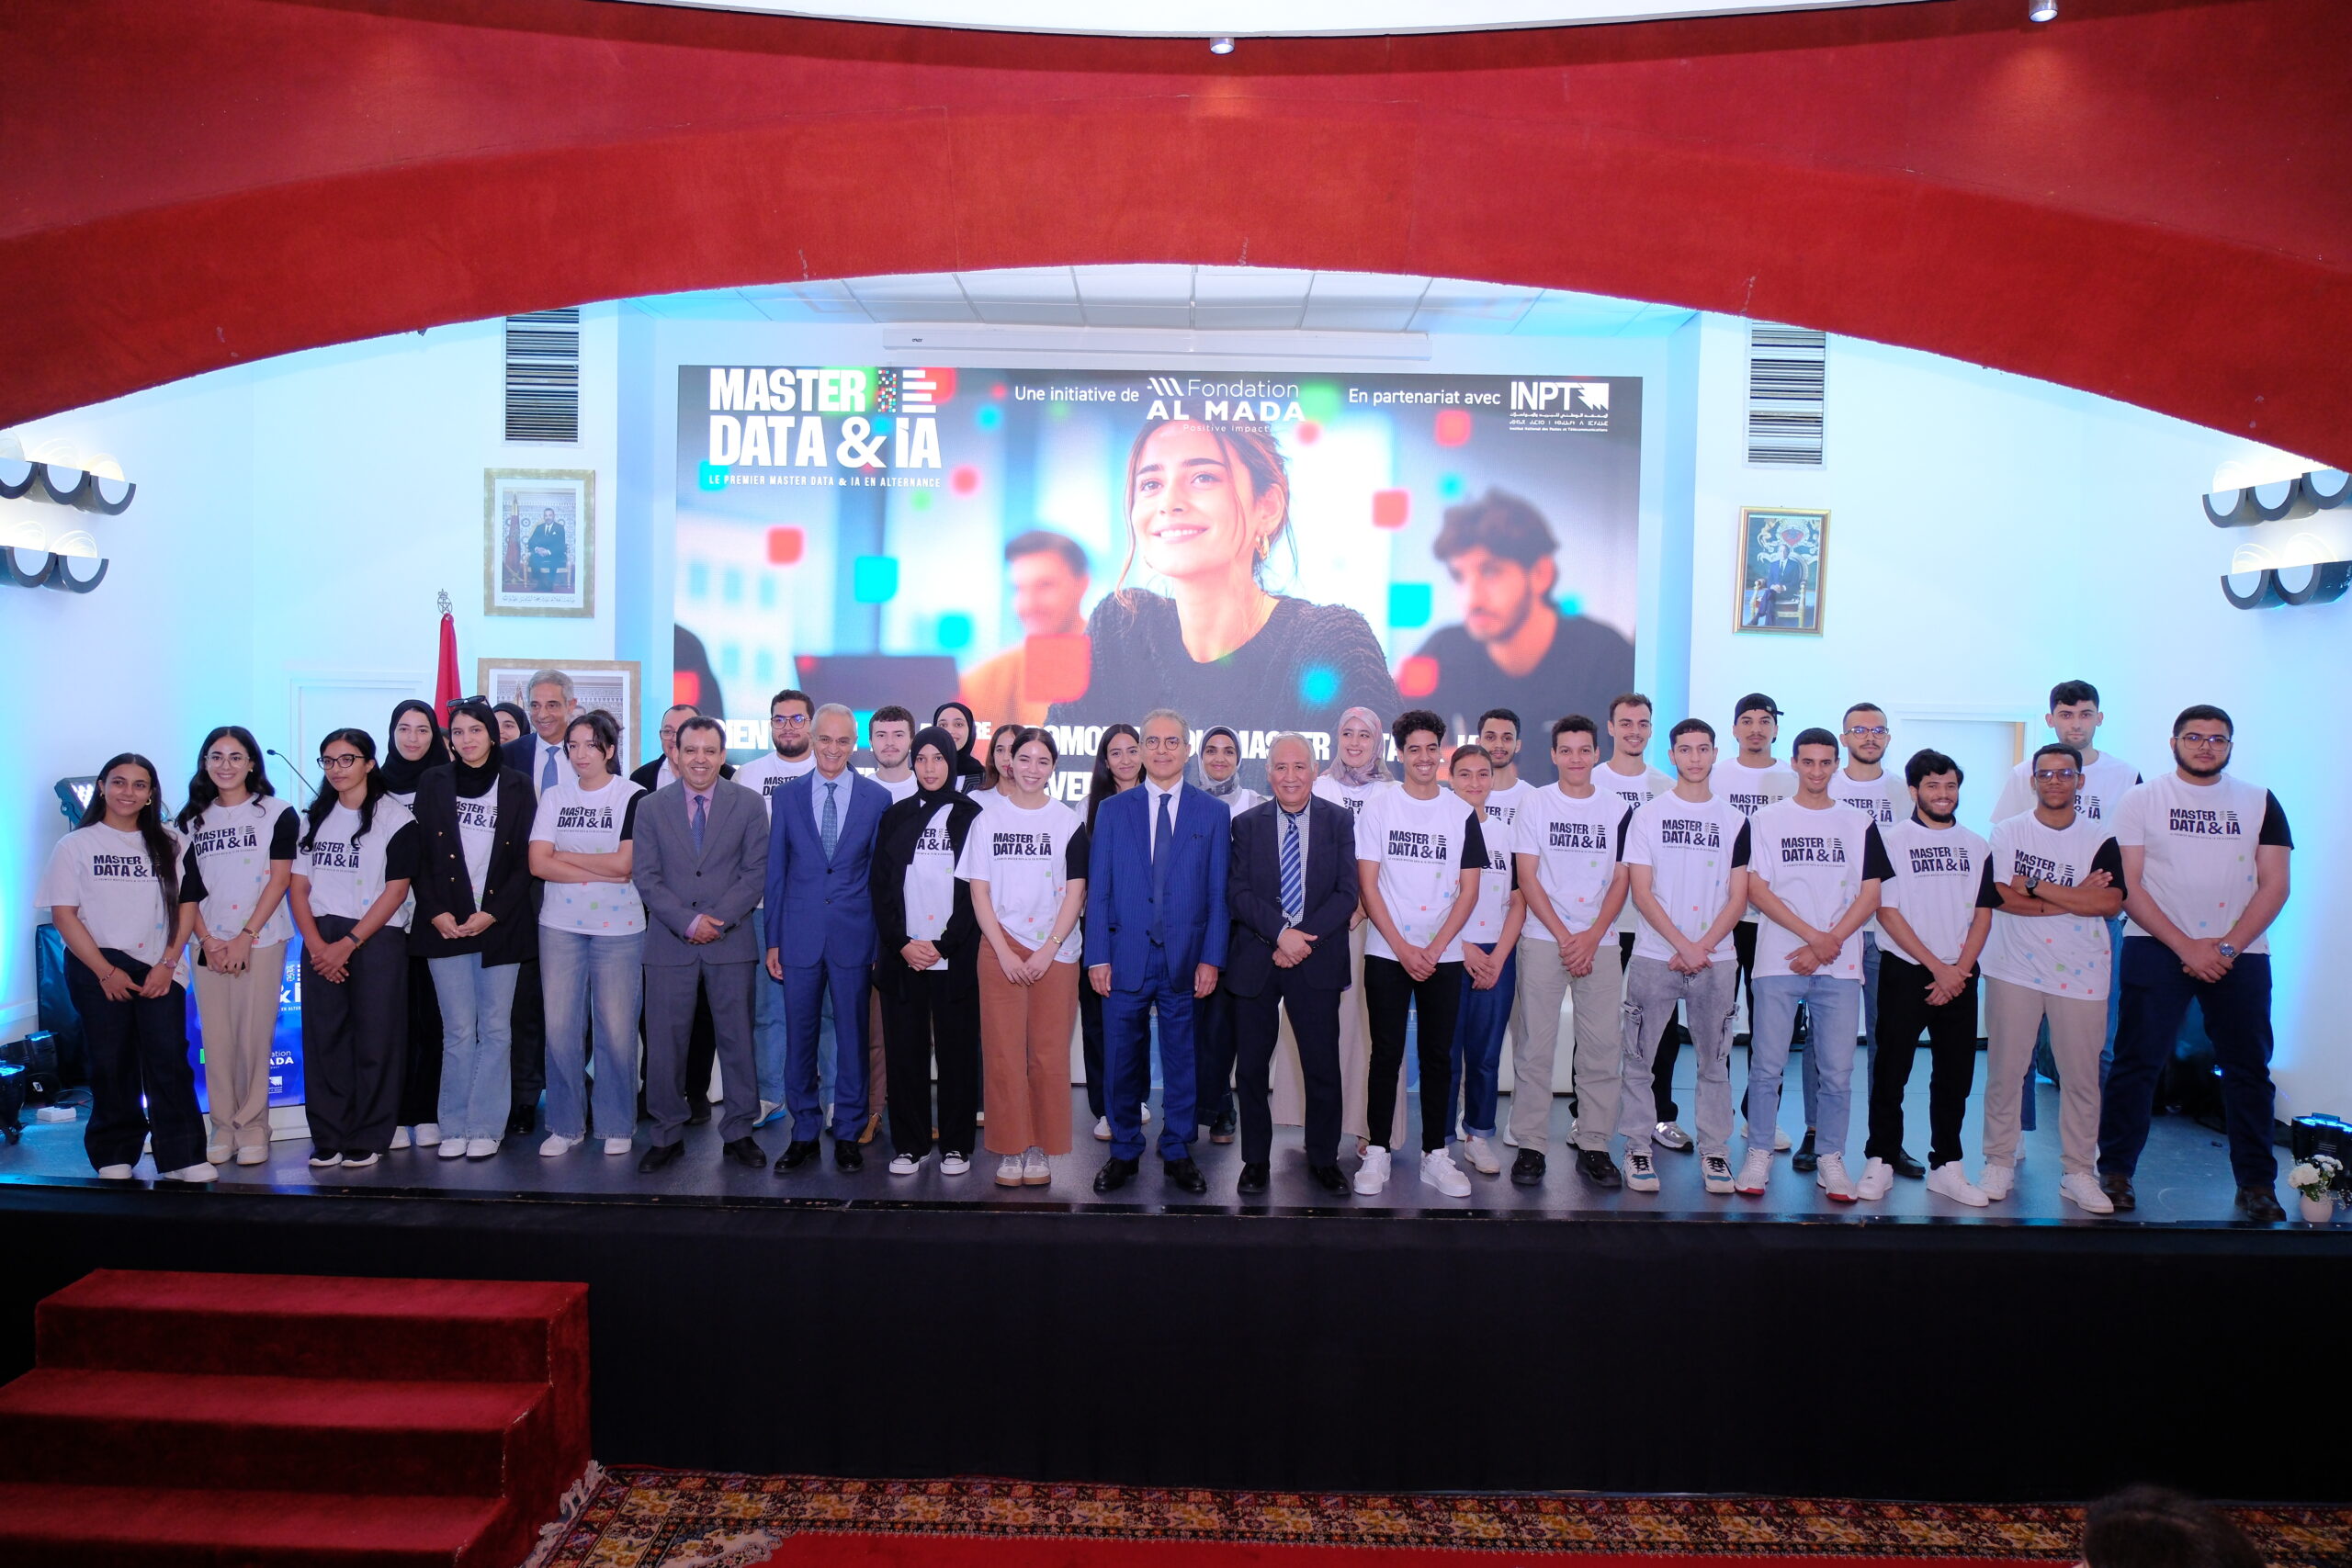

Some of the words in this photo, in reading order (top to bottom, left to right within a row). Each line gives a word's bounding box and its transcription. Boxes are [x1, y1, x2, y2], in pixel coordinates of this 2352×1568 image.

[709, 367, 866, 412] MASTER
[1015, 386, 1046, 400] Une
[1050, 387, 1116, 401] initiative
[1121, 388, 1139, 401] de
[1188, 379, 1299, 398] Fondation
[1349, 389, 1368, 403] En
[1373, 389, 1460, 406] partenariat
[1464, 392, 1500, 405] avec
[1510, 381, 1582, 411] INPT
[1146, 400, 1190, 421] AL
[1204, 400, 1306, 422] MADA
[1183, 423, 1227, 433] Positive
[709, 415, 828, 467] DATA
[836, 416, 888, 468] &
[709, 475, 720, 484] LE
[724, 475, 765, 485] PREMIER
[770, 476, 807, 486] MASTER
[811, 477, 834, 486] DATA
[838, 478, 847, 486] &
[851, 477, 860, 486] IA
[865, 478, 876, 487] EN
[880, 478, 941, 488] ALTERNANCE
[1730, 794, 1769, 805] MASTER
[560, 806, 597, 817] MASTER
[2169, 808, 2216, 821] MASTER
[474, 815, 487, 827] &
[557, 816, 584, 828] DATA
[586, 818, 599, 828] &
[1662, 819, 1702, 831] MASTER
[2169, 818, 2205, 833] DATA
[2208, 821, 2223, 835] &
[1550, 822, 1589, 835] MASTER
[194, 828, 235, 843] MASTER
[993, 832, 1034, 843] MASTER
[1389, 829, 1429, 845] MASTER
[1550, 833, 1579, 847] DATA
[1581, 835, 1594, 848] &
[1662, 830, 1690, 844] DATA
[1692, 832, 1706, 846] &
[195, 839, 225, 856] DATA
[228, 837, 241, 848] &
[927, 838, 940, 851] &
[993, 843, 1023, 856] DATA
[1024, 843, 1037, 855] &
[1781, 837, 1824, 849] MASTER
[1388, 841, 1419, 857] DATA
[1420, 845, 1433, 859] &
[1781, 848, 1814, 863] DATA
[1816, 849, 1830, 863] &
[1909, 846, 1951, 859] MASTER
[94, 854, 141, 864] MASTER
[334, 854, 346, 867] &
[2015, 849, 2056, 872] MASTER
[94, 864, 130, 876] DATA
[133, 865, 148, 877] &
[1911, 858, 1944, 874] DATA
[1946, 858, 1958, 872] &
[2043, 872, 2058, 884] &
